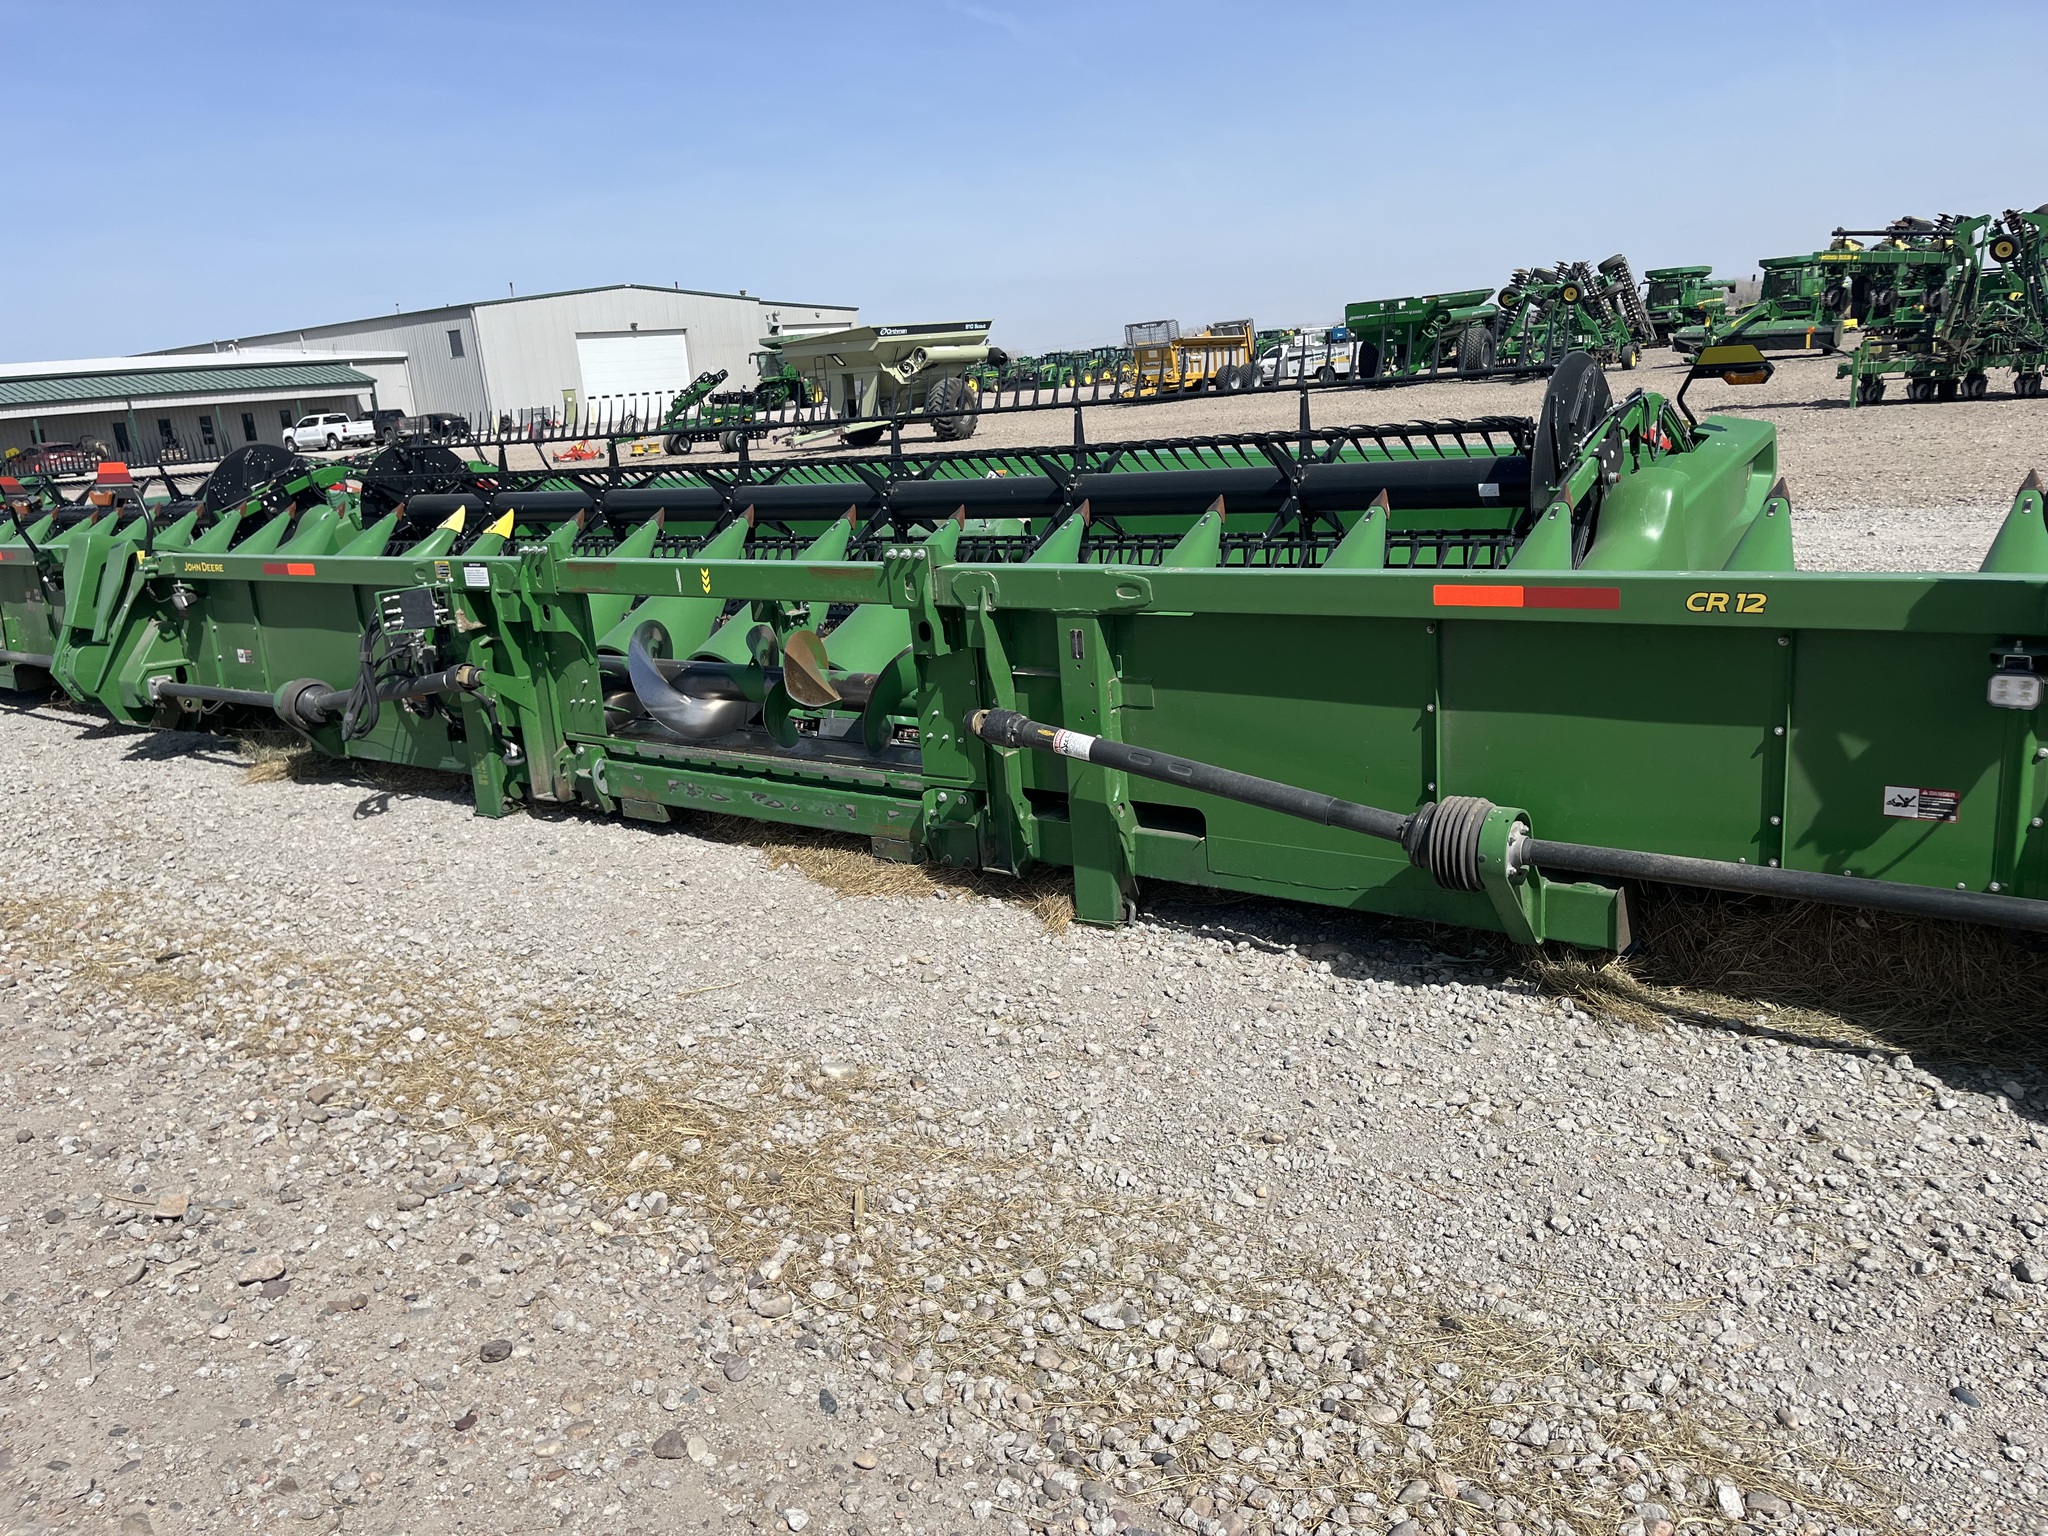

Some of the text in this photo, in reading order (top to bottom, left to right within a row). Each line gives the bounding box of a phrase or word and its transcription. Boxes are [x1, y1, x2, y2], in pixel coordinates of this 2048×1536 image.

[974, 322, 987, 330] Scout
[184, 561, 225, 573] JOHN DEERE
[1685, 591, 1768, 614] CR 12
[1929, 790, 1956, 798] DANGER
